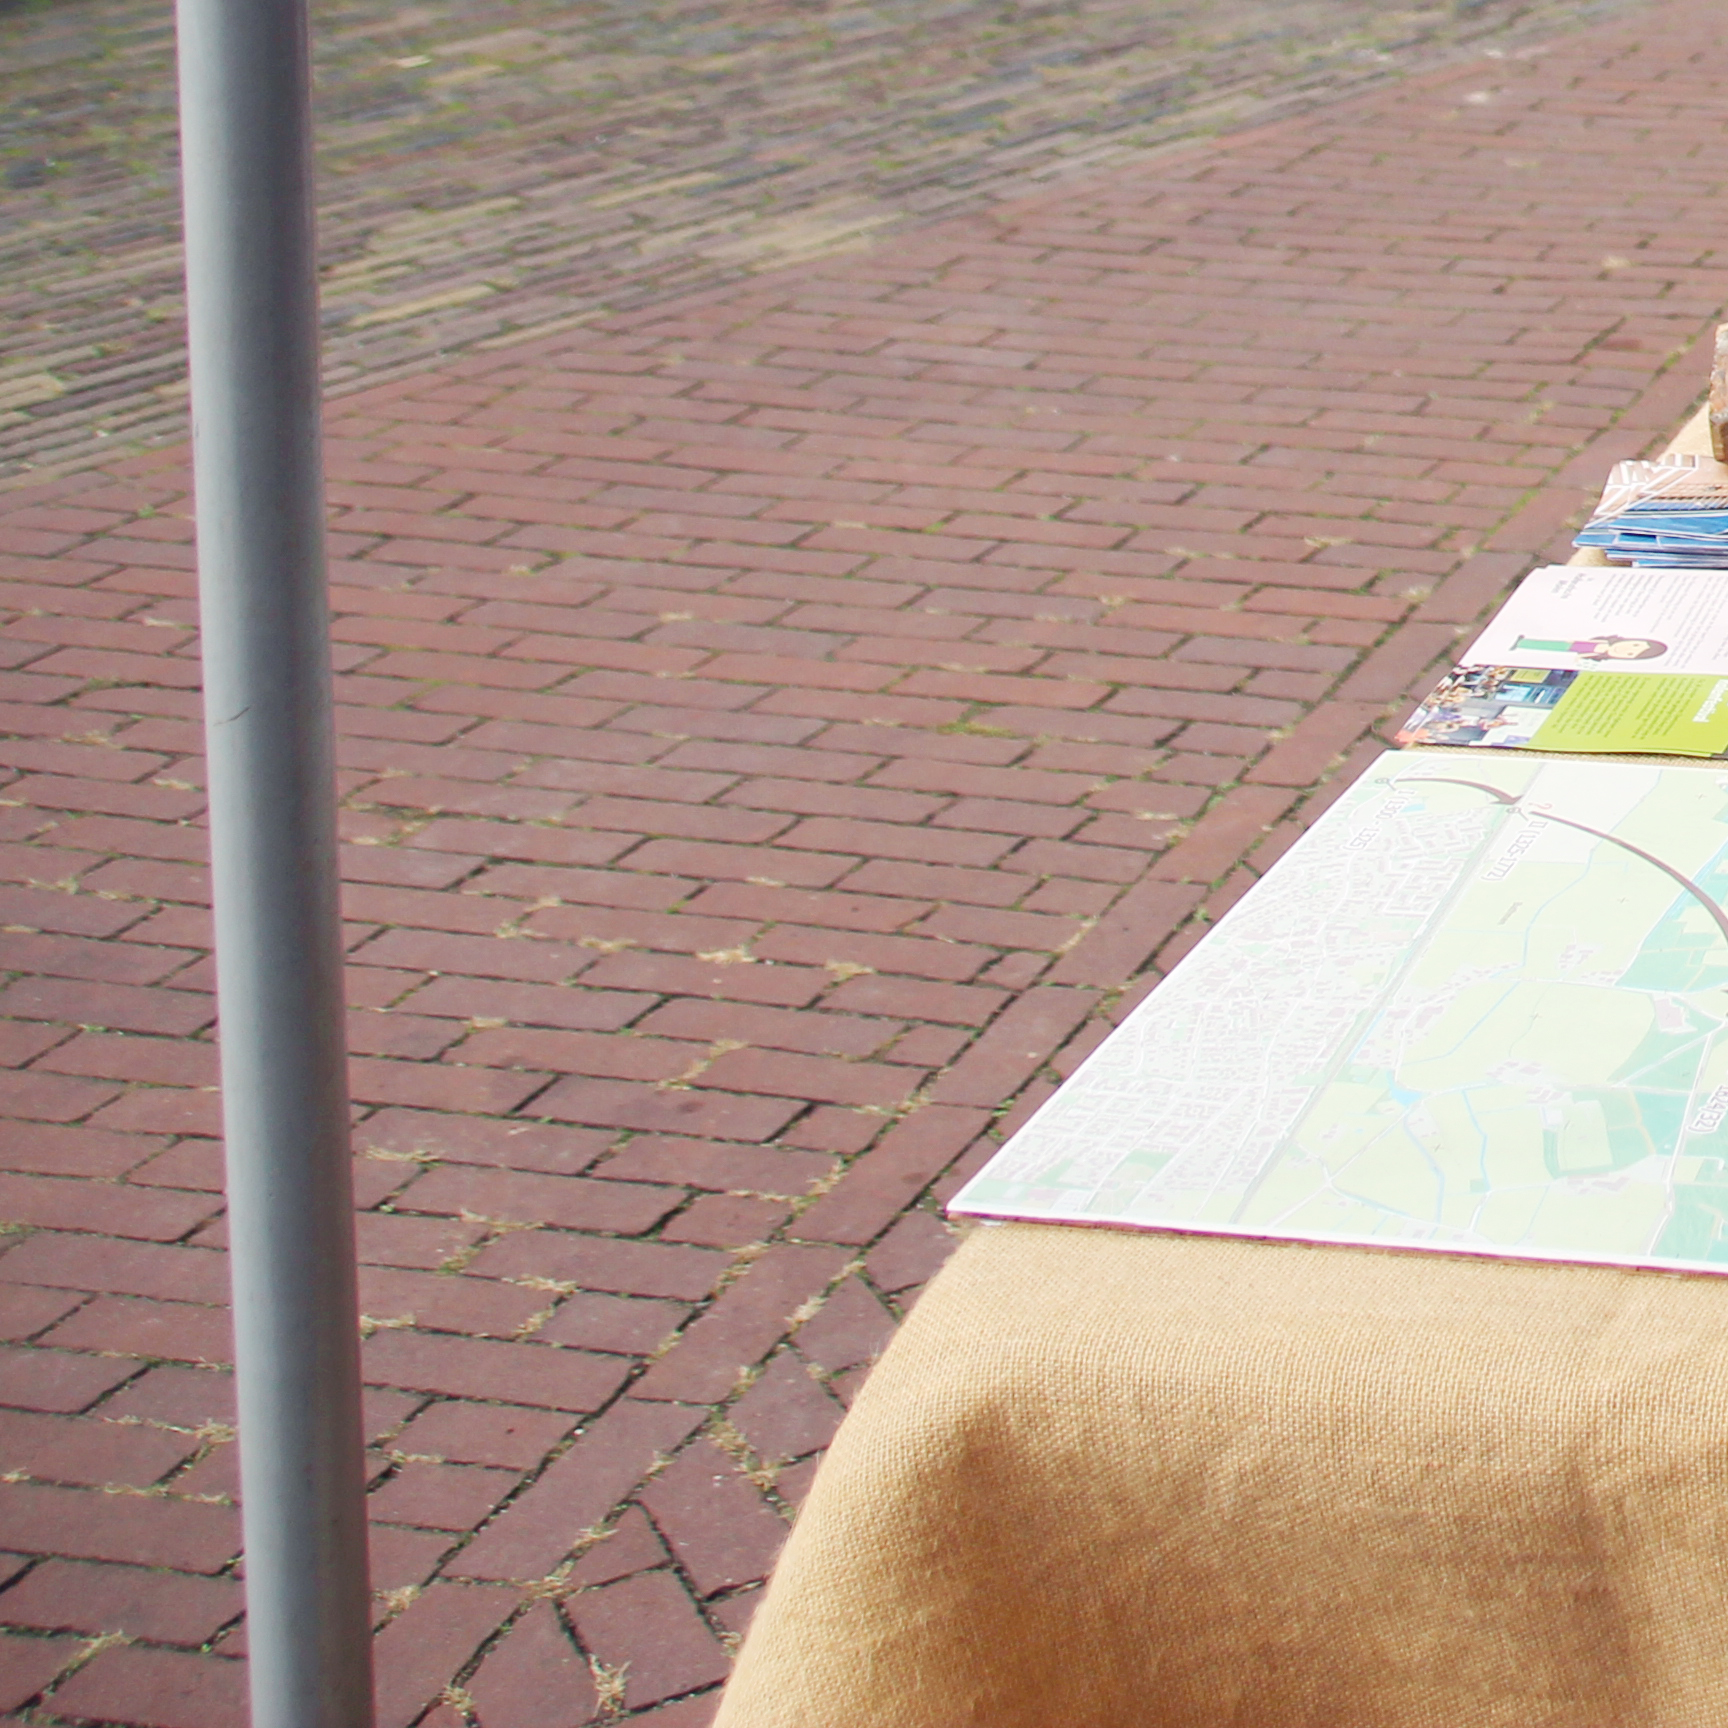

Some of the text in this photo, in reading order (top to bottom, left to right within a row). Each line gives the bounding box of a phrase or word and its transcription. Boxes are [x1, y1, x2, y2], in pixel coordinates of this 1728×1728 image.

[1375, 795, 1410, 819] (1300
[1342, 827, 1376, 852] 1325)
[1481, 829, 1543, 882] (1325-1772)
